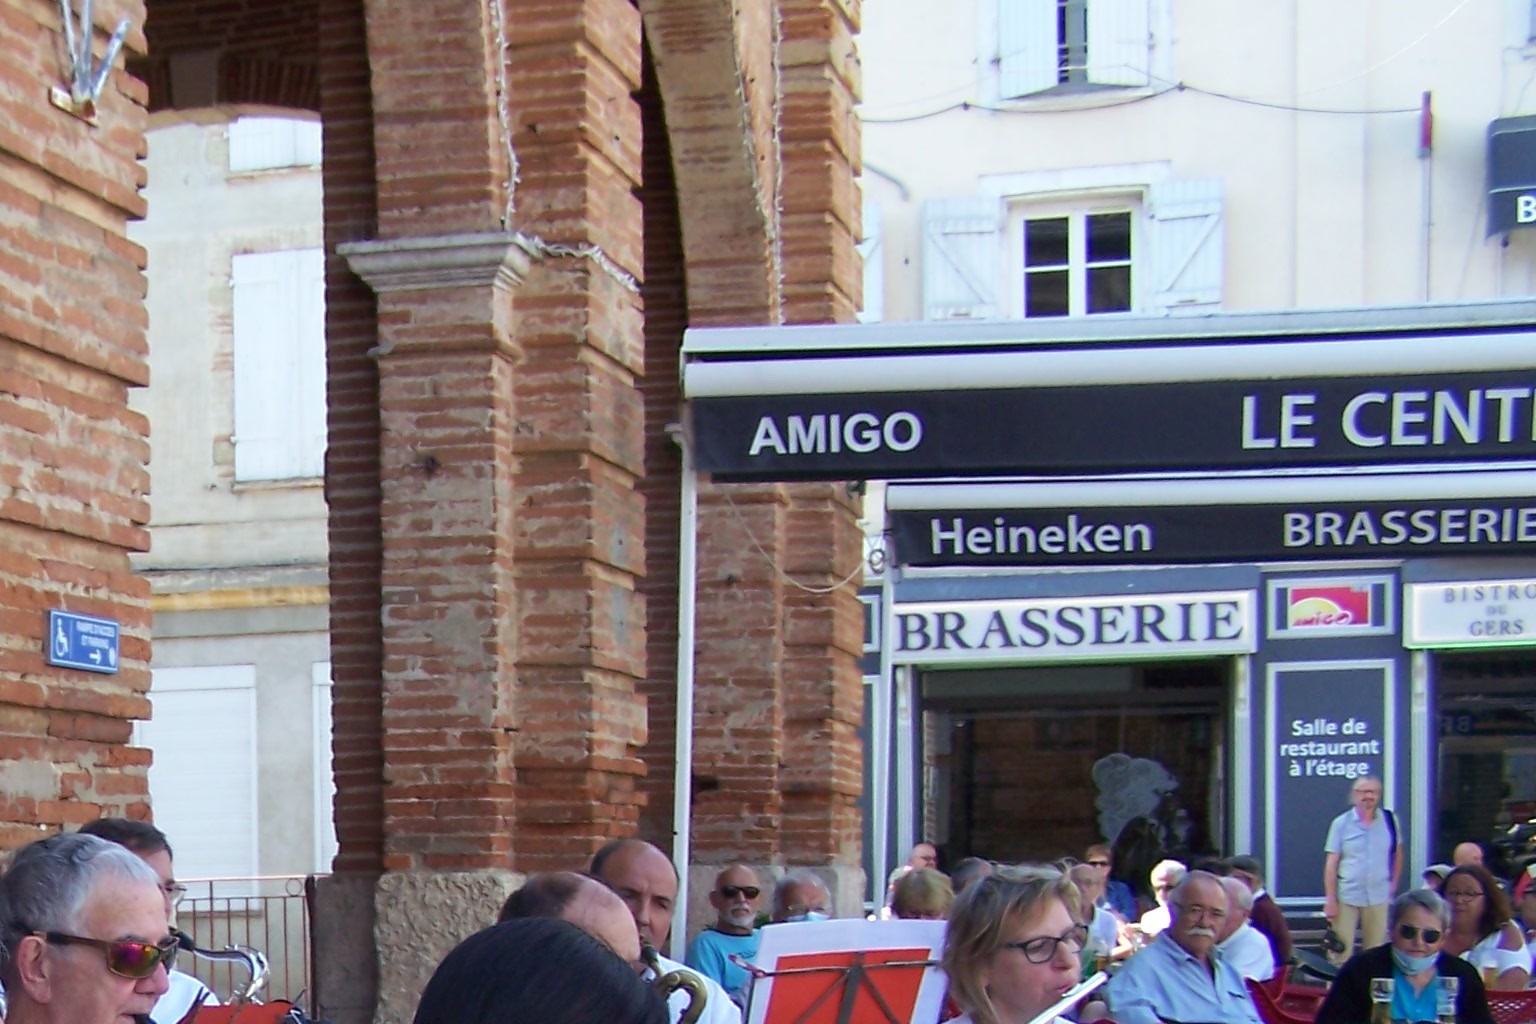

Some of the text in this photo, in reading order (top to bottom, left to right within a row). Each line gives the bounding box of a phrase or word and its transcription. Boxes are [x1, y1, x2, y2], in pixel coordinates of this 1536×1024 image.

[748, 410, 923, 456] AMIGO
[1241, 387, 1536, 449] LE CENT
[930, 513, 1153, 555] Heineken
[1282, 507, 1536, 548] BRASSERIE
[894, 600, 1244, 653] BRASSERIE
[1469, 618, 1525, 637] GERS
[1291, 718, 1368, 736] Salle de
[1280, 739, 1380, 757] restaurant
[1289, 759, 1302, 777] à
